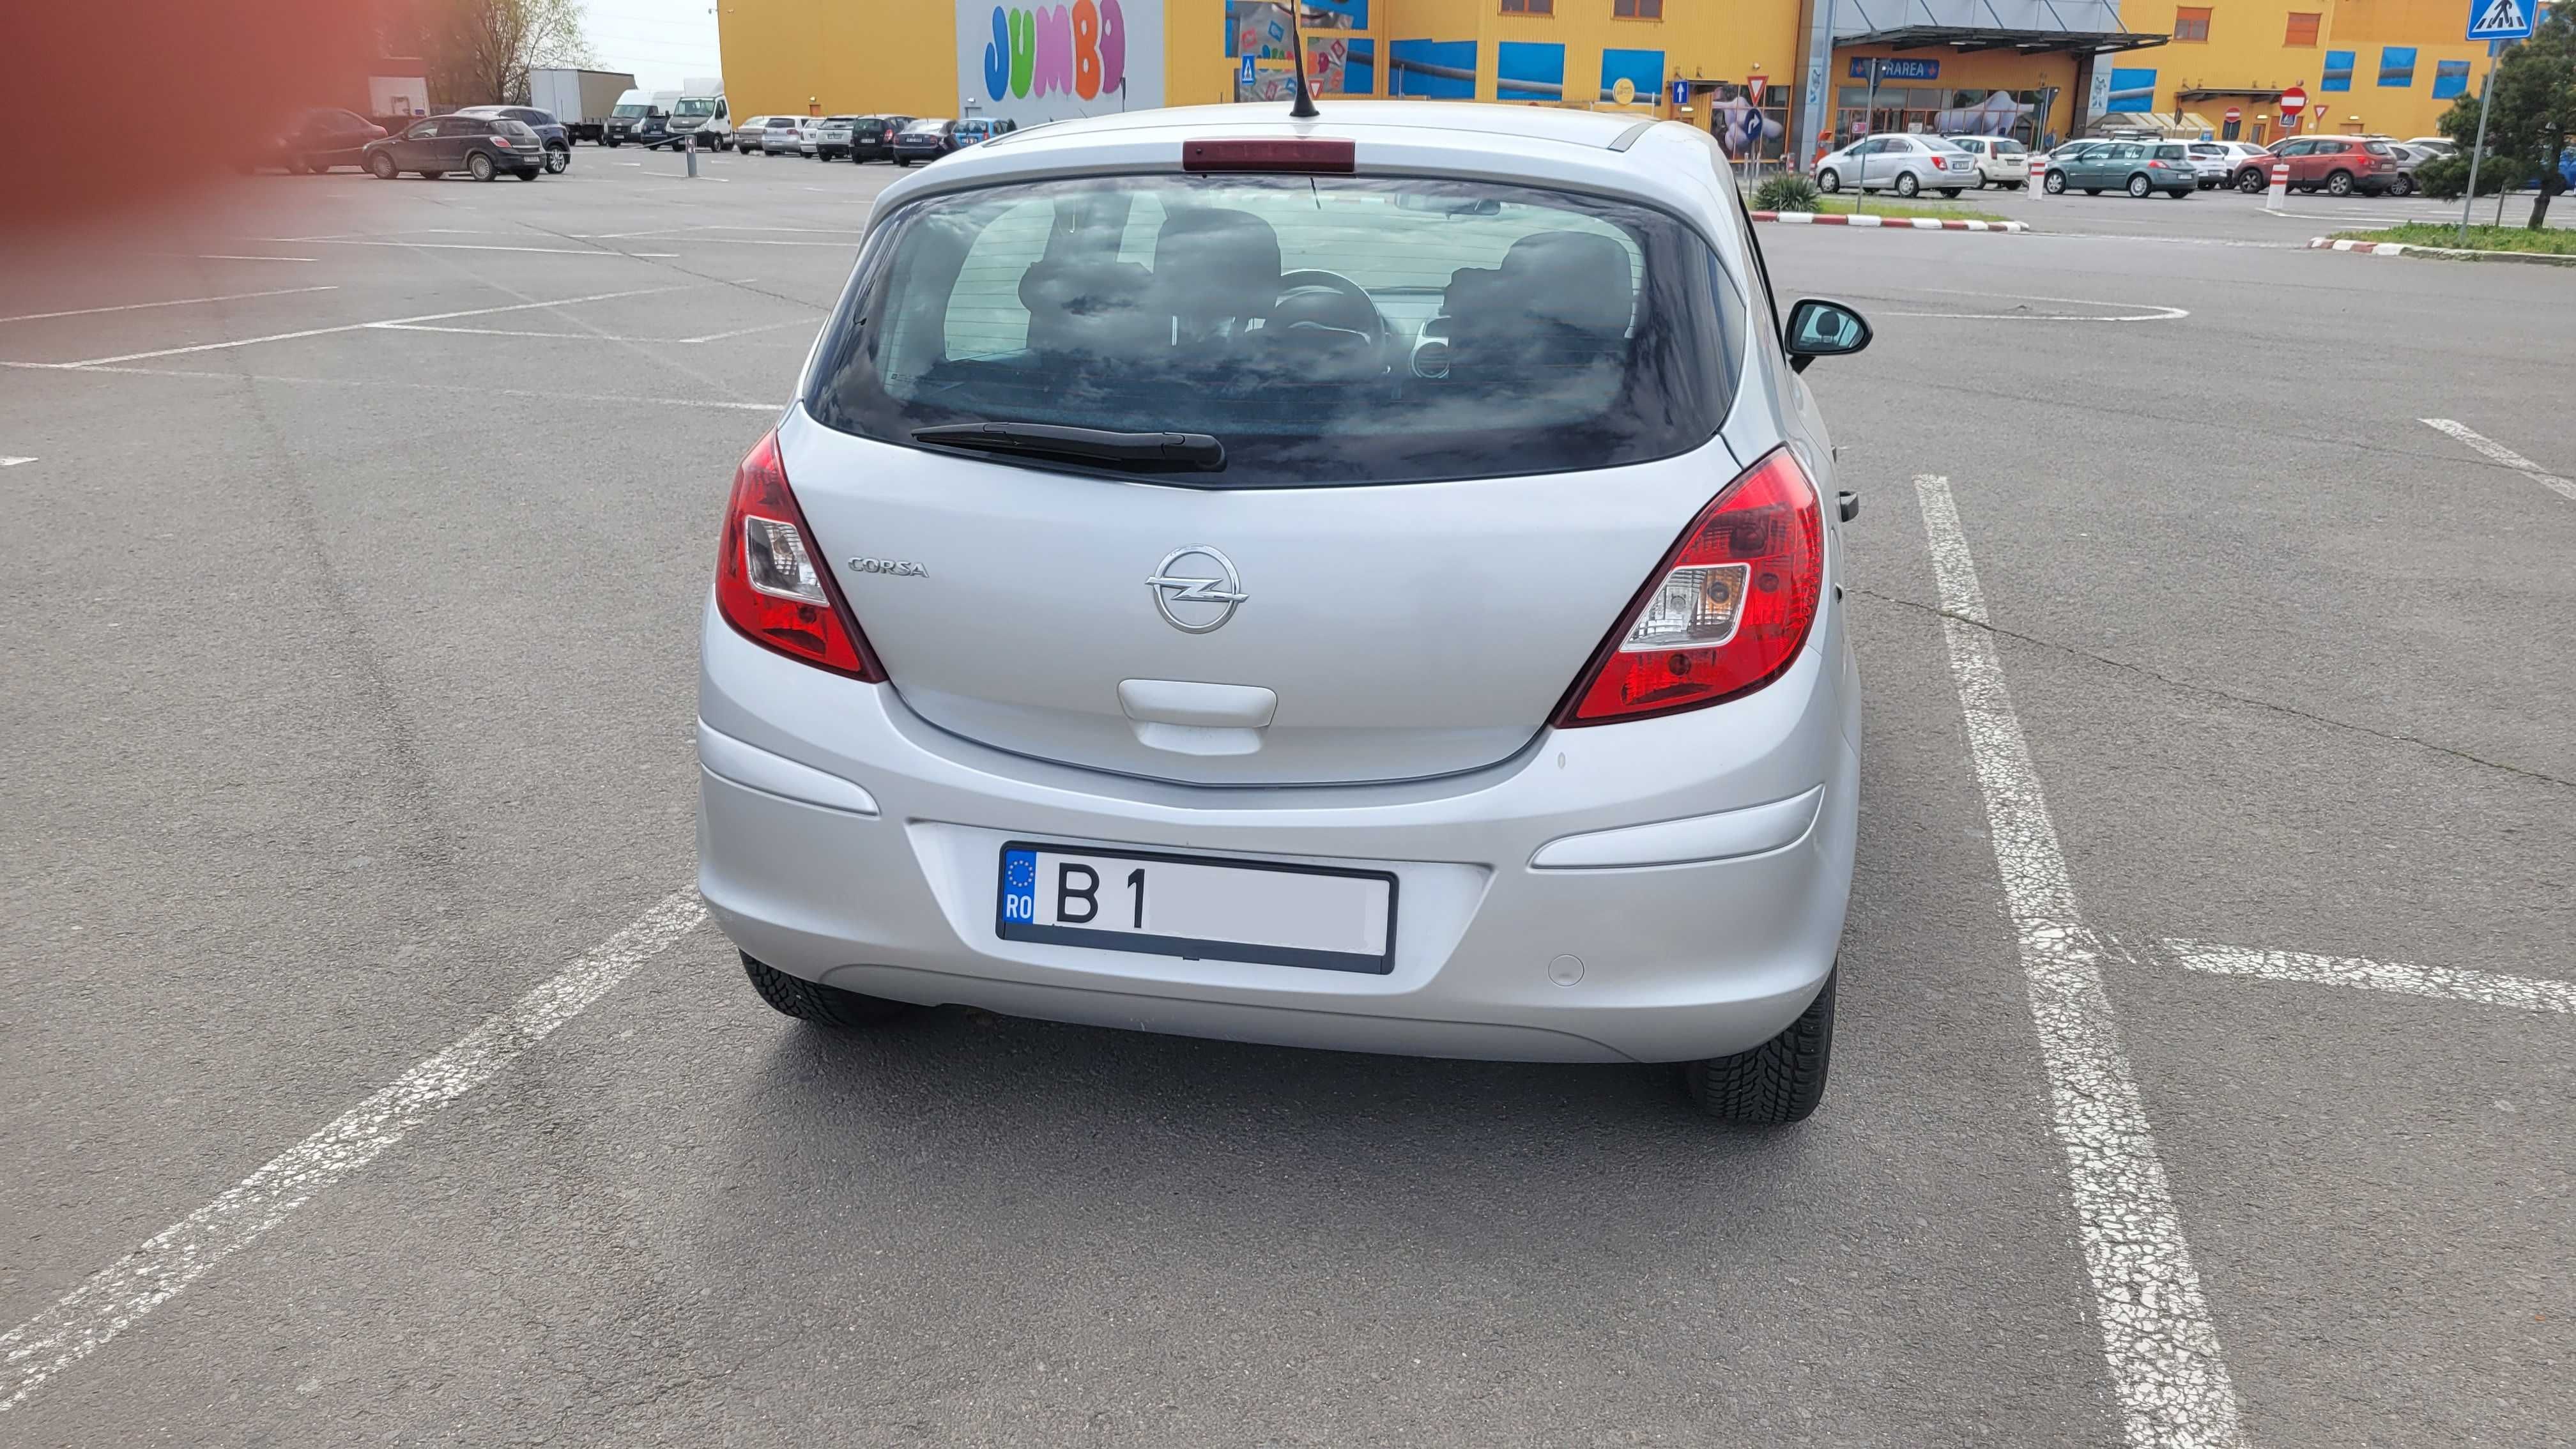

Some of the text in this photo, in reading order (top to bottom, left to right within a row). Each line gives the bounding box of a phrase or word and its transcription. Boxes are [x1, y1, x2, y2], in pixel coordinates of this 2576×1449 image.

[985, 0, 1125, 102] JUMBO
[1885, 61, 1924, 76] RAREA
[848, 556, 930, 578] CORSA
[1006, 894, 1032, 919] RO
[1057, 862, 1145, 928] B 1
